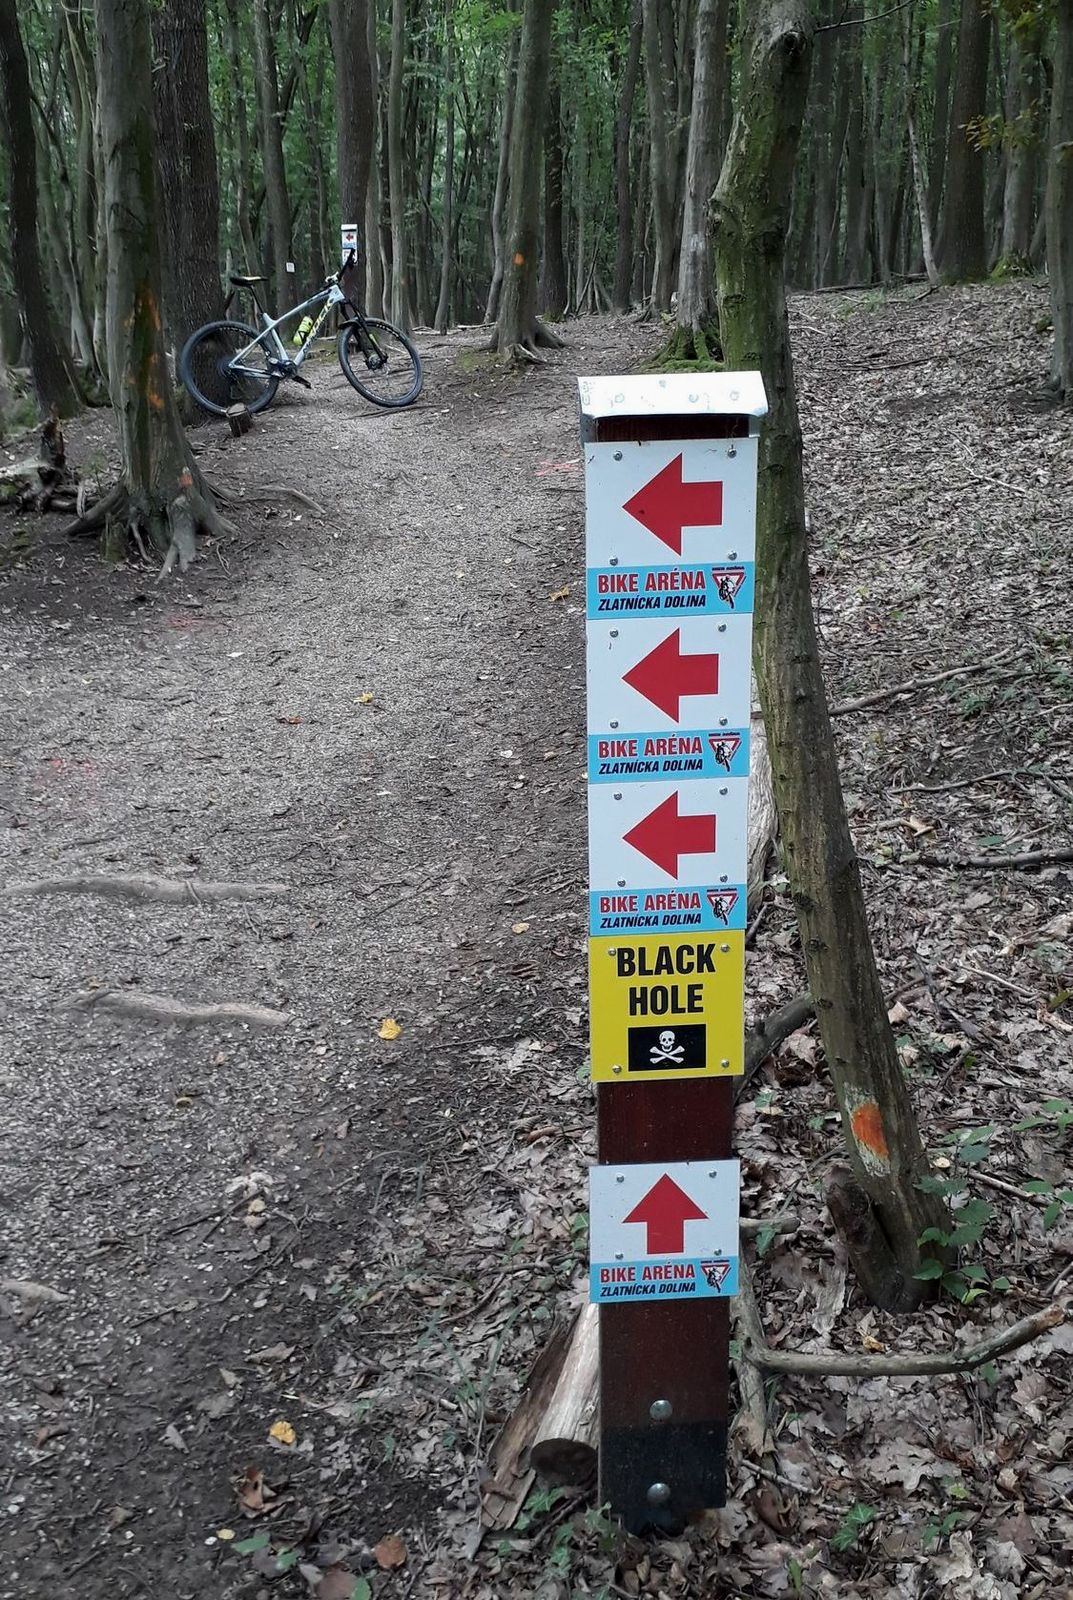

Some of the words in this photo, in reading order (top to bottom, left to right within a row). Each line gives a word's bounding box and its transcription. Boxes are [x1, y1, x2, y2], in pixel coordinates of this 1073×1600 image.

[598, 574, 638, 593] BIKE
[645, 568, 706, 591] ARÉNA
[598, 595, 661, 611] ZLATNÍCKA
[664, 594, 706, 609] DOLINA
[598, 739, 638, 758] BIKE
[644, 734, 703, 756] ARÉNA
[598, 759, 660, 775] ZLATNÍCKA
[662, 758, 703, 772] DOLINA
[600, 895, 638, 913] BIKE
[644, 890, 701, 911] ARÉNA
[600, 914, 659, 929] ZLATNÍCKA
[662, 913, 701, 926] DOLINA
[617, 943, 716, 977] BLACK
[629, 984, 704, 1016] HOLE
[600, 1267, 636, 1283] BIKE
[642, 1262, 696, 1281] ARÉNA
[600, 1284, 656, 1297] ZLATNÍCKA
[659, 1282, 696, 1294] DOLINA
